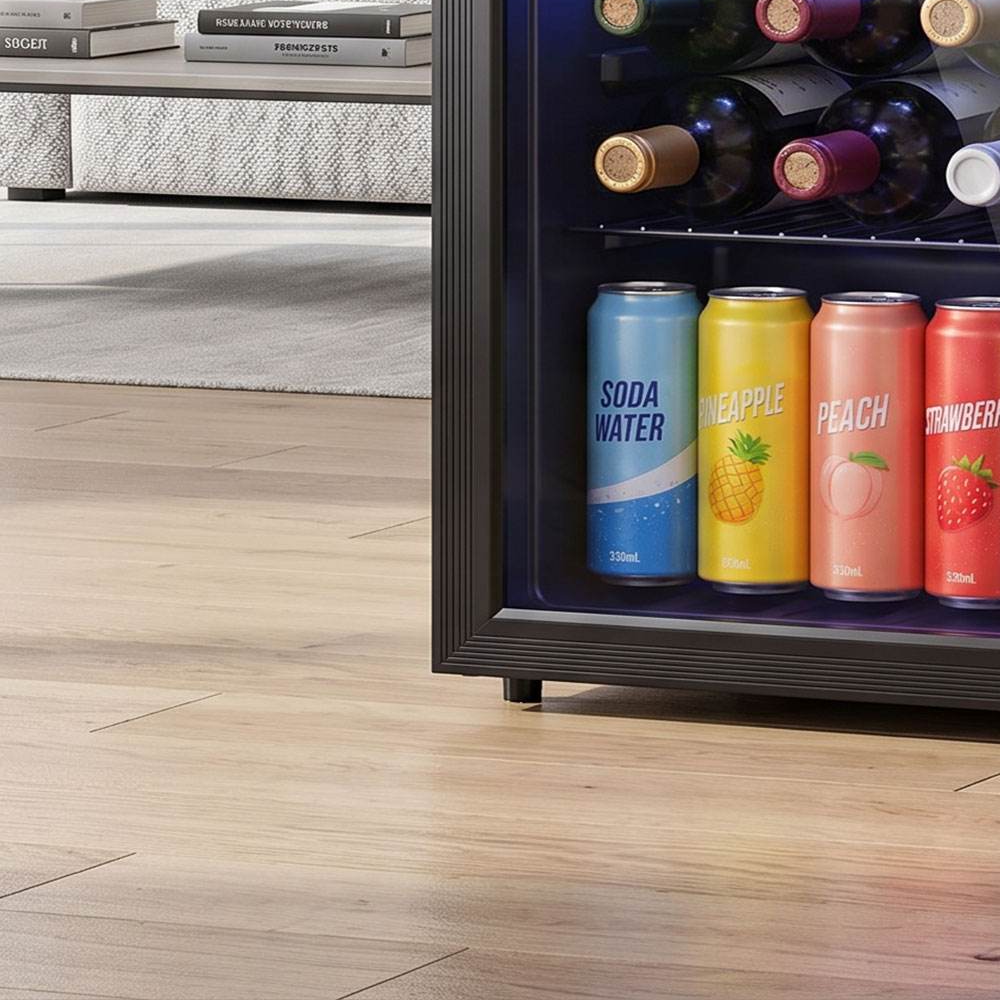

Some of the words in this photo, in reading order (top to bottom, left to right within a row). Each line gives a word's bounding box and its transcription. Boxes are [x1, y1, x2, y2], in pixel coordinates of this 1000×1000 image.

[600, 380, 659, 408] SODA
[595, 413, 666, 442] WATER
[816, 393, 891, 435] PEACH
[609, 550, 641, 563] 330mL
